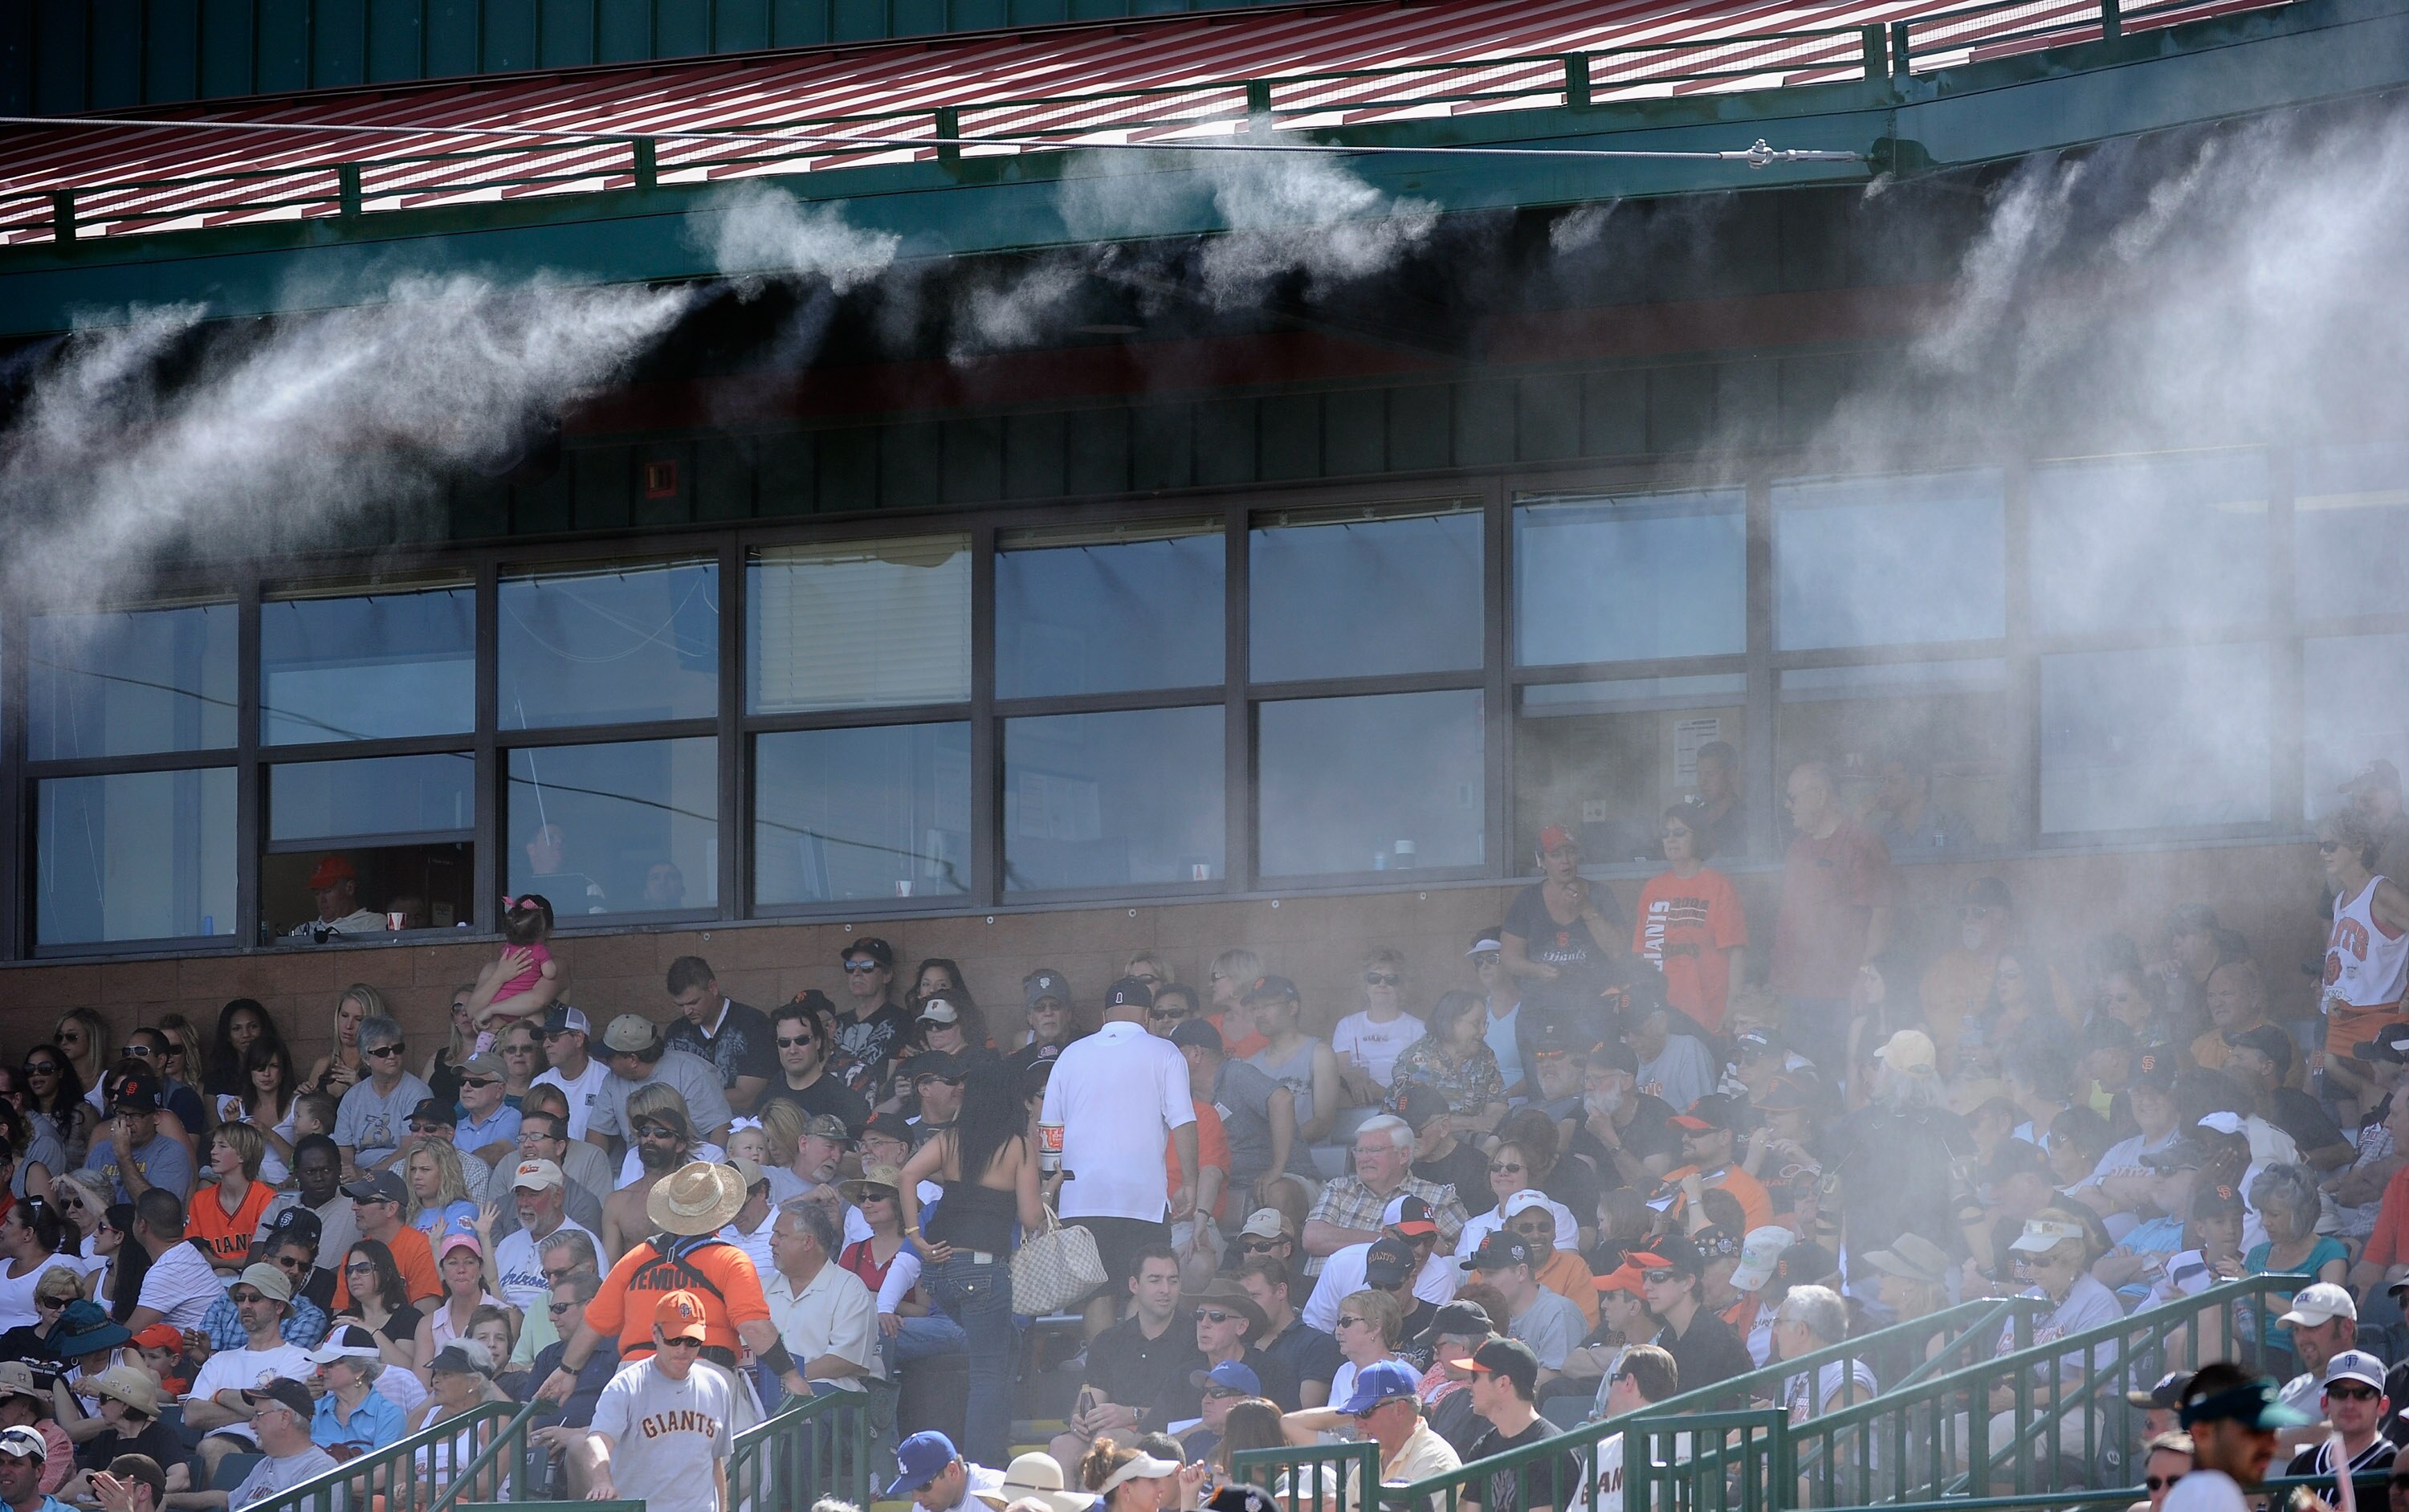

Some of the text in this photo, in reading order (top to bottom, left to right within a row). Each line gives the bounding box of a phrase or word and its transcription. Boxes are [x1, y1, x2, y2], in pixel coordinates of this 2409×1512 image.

[1642, 900, 1671, 972] IANTS
[2142, 1055, 2155, 1073] SF
[126, 1081, 137, 1096] SF
[2217, 1184, 2232, 1200] SF
[281, 1212, 294, 1228] SF
[1368, 1251, 1396, 1265] GIANTS
[679, 1302, 691, 1318] SF
[643, 1410, 717, 1438] GIANTS
